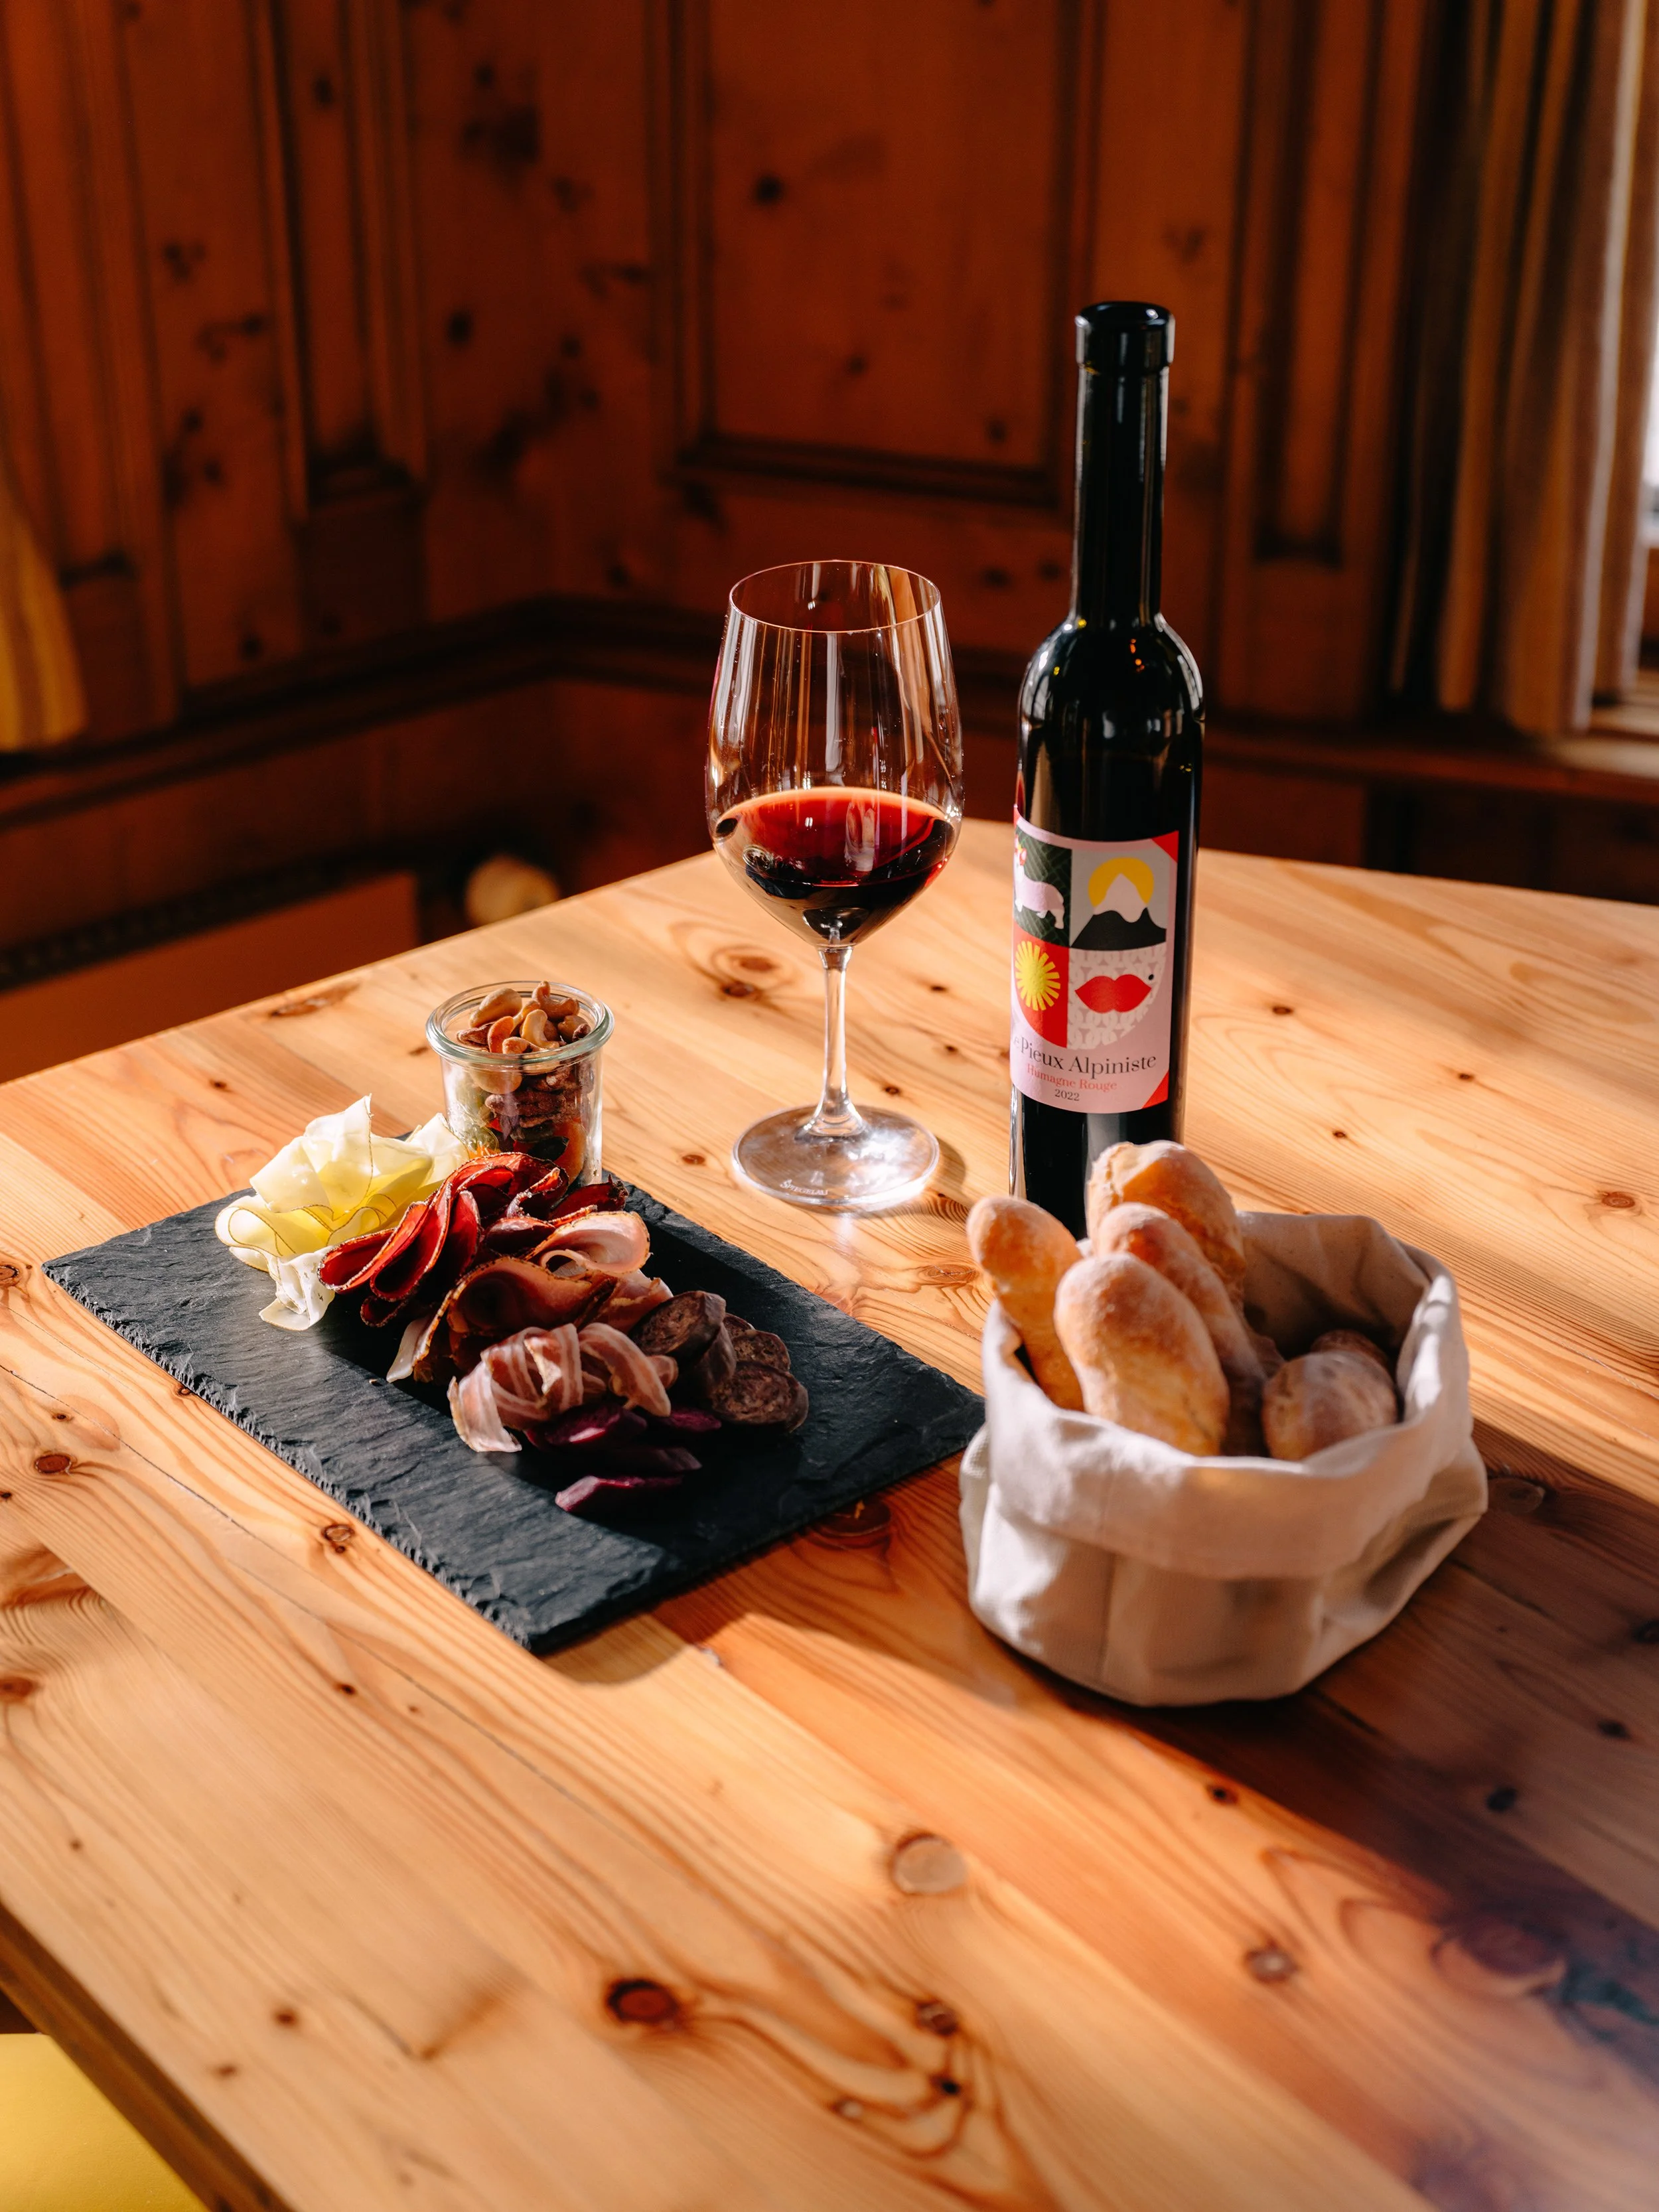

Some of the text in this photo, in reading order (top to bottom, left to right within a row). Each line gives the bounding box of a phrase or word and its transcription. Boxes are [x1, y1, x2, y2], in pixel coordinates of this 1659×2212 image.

[1021, 1037, 1064, 1070] Pieux
[1068, 1056, 1157, 1079] Alpiniste
[1027, 1064, 1118, 1092] Humagne Rouge
[1054, 1089, 1080, 1101] 2022
